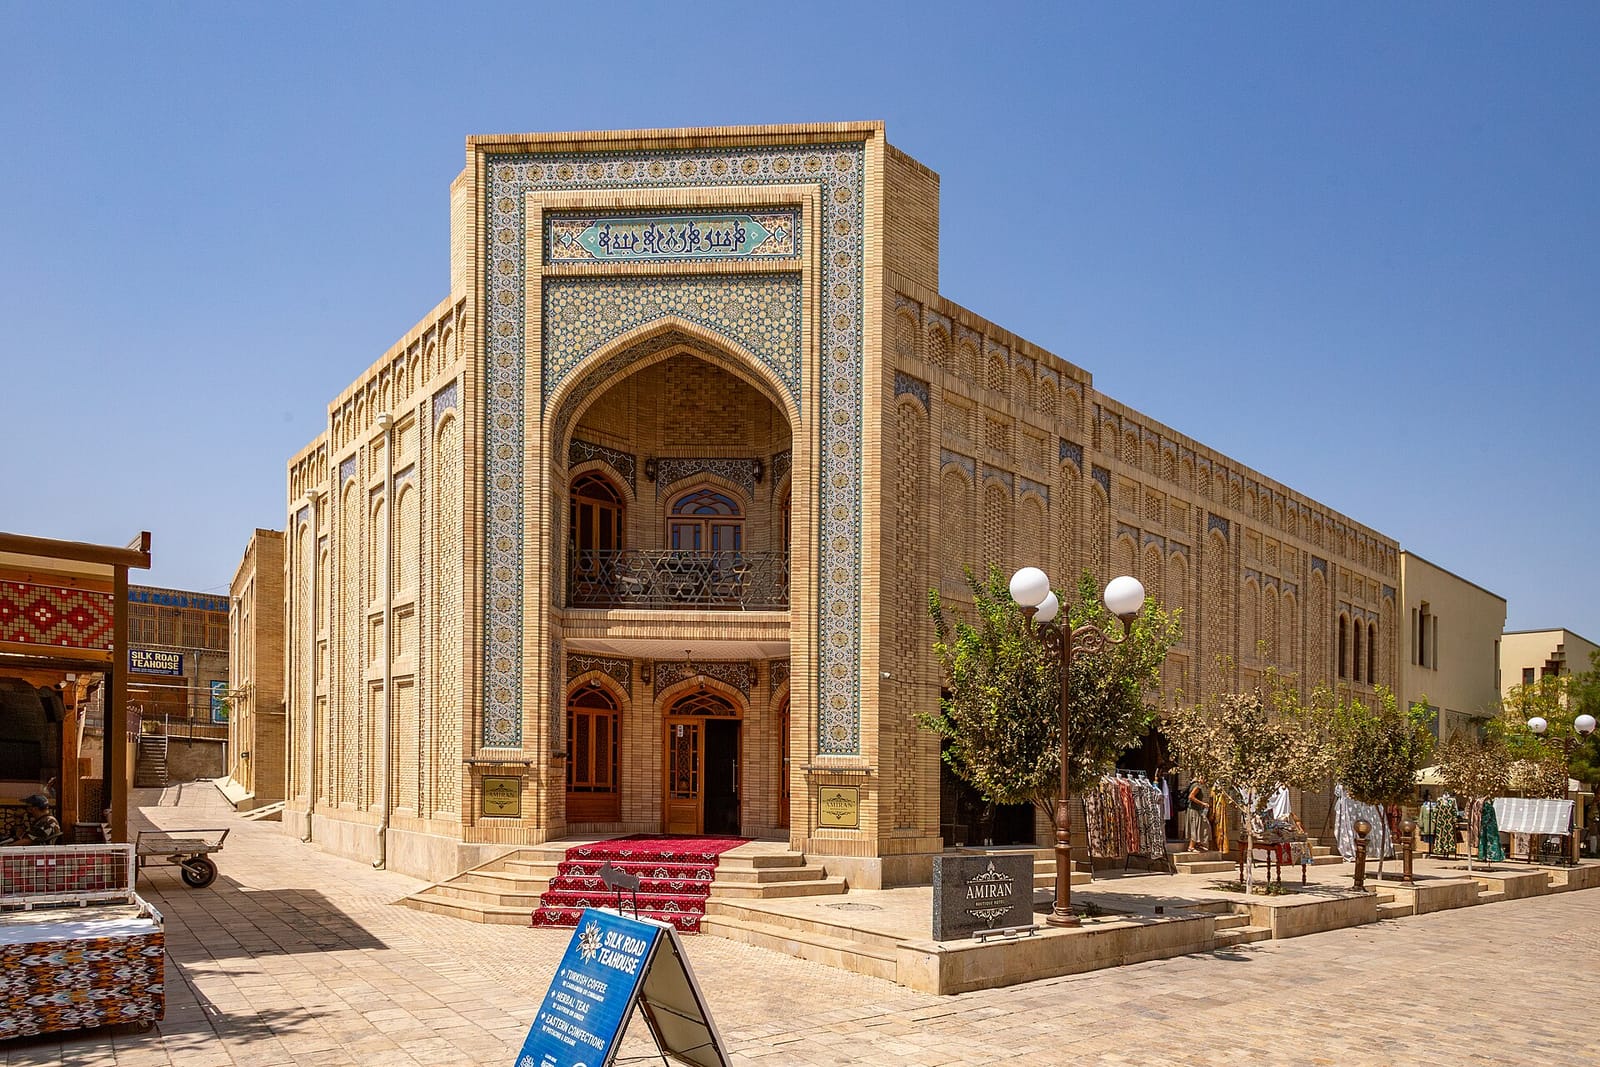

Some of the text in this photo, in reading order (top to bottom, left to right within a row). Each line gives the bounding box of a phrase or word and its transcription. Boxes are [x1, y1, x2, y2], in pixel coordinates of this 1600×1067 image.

[131, 651, 179, 662] SILK ROAD
[131, 659, 179, 670] TEAHOUSE
[966, 883, 1012, 899] AMIRAN
[604, 931, 646, 956] SILK ROAD
[598, 948, 639, 974] TEAHOUSE
[566, 970, 608, 994] TURKISH COFFEE
[556, 992, 590, 1013] HERBAL TEAS
[545, 1014, 605, 1050] EASTERN CONFECTIONS
